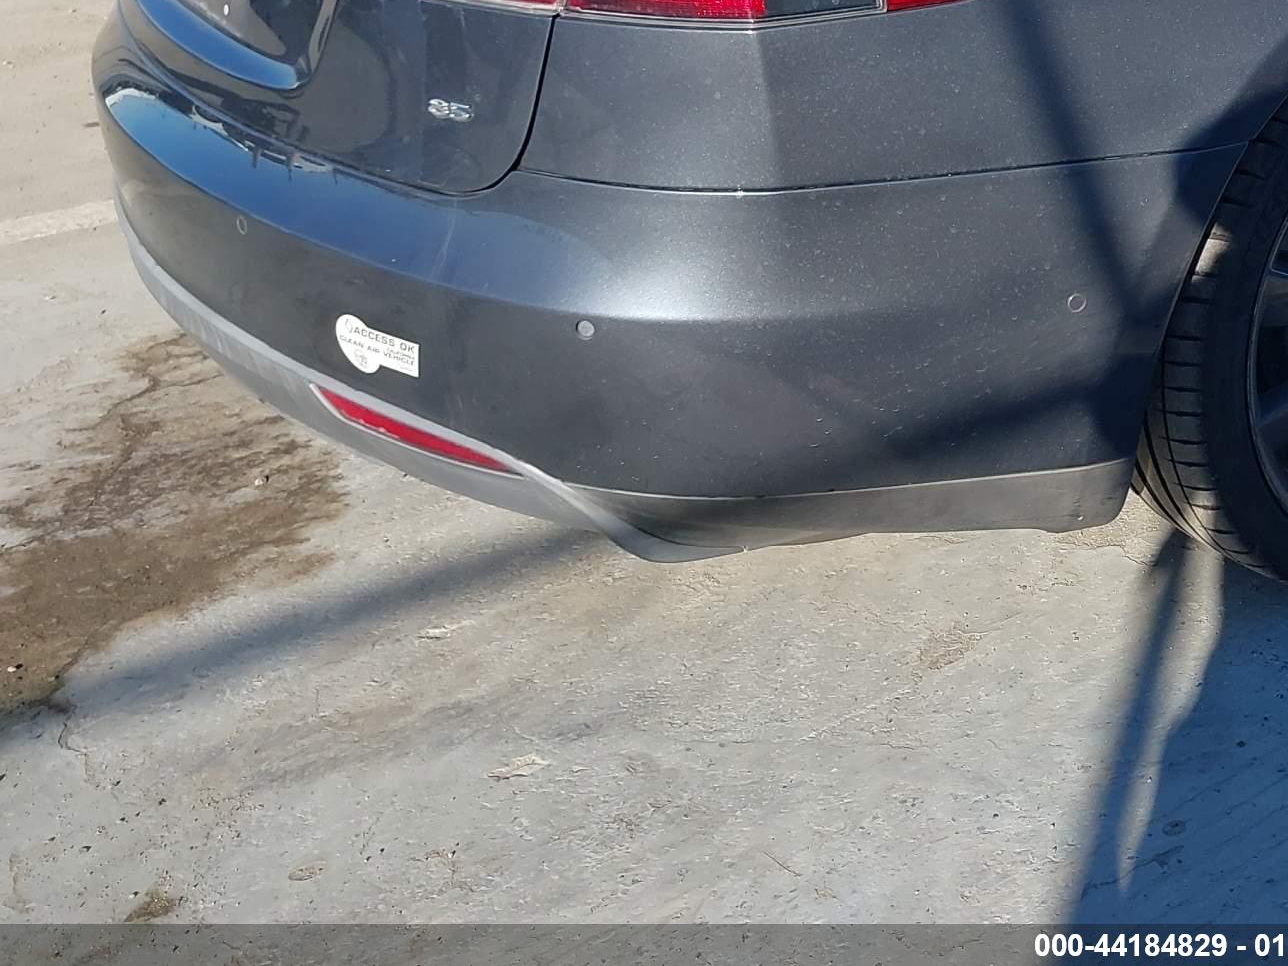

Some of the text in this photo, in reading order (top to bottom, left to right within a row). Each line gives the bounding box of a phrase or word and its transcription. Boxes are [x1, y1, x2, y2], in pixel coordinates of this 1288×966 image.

[339, 335, 364, 348] CLEAN
[353, 326, 415, 354] ACCESS OK
